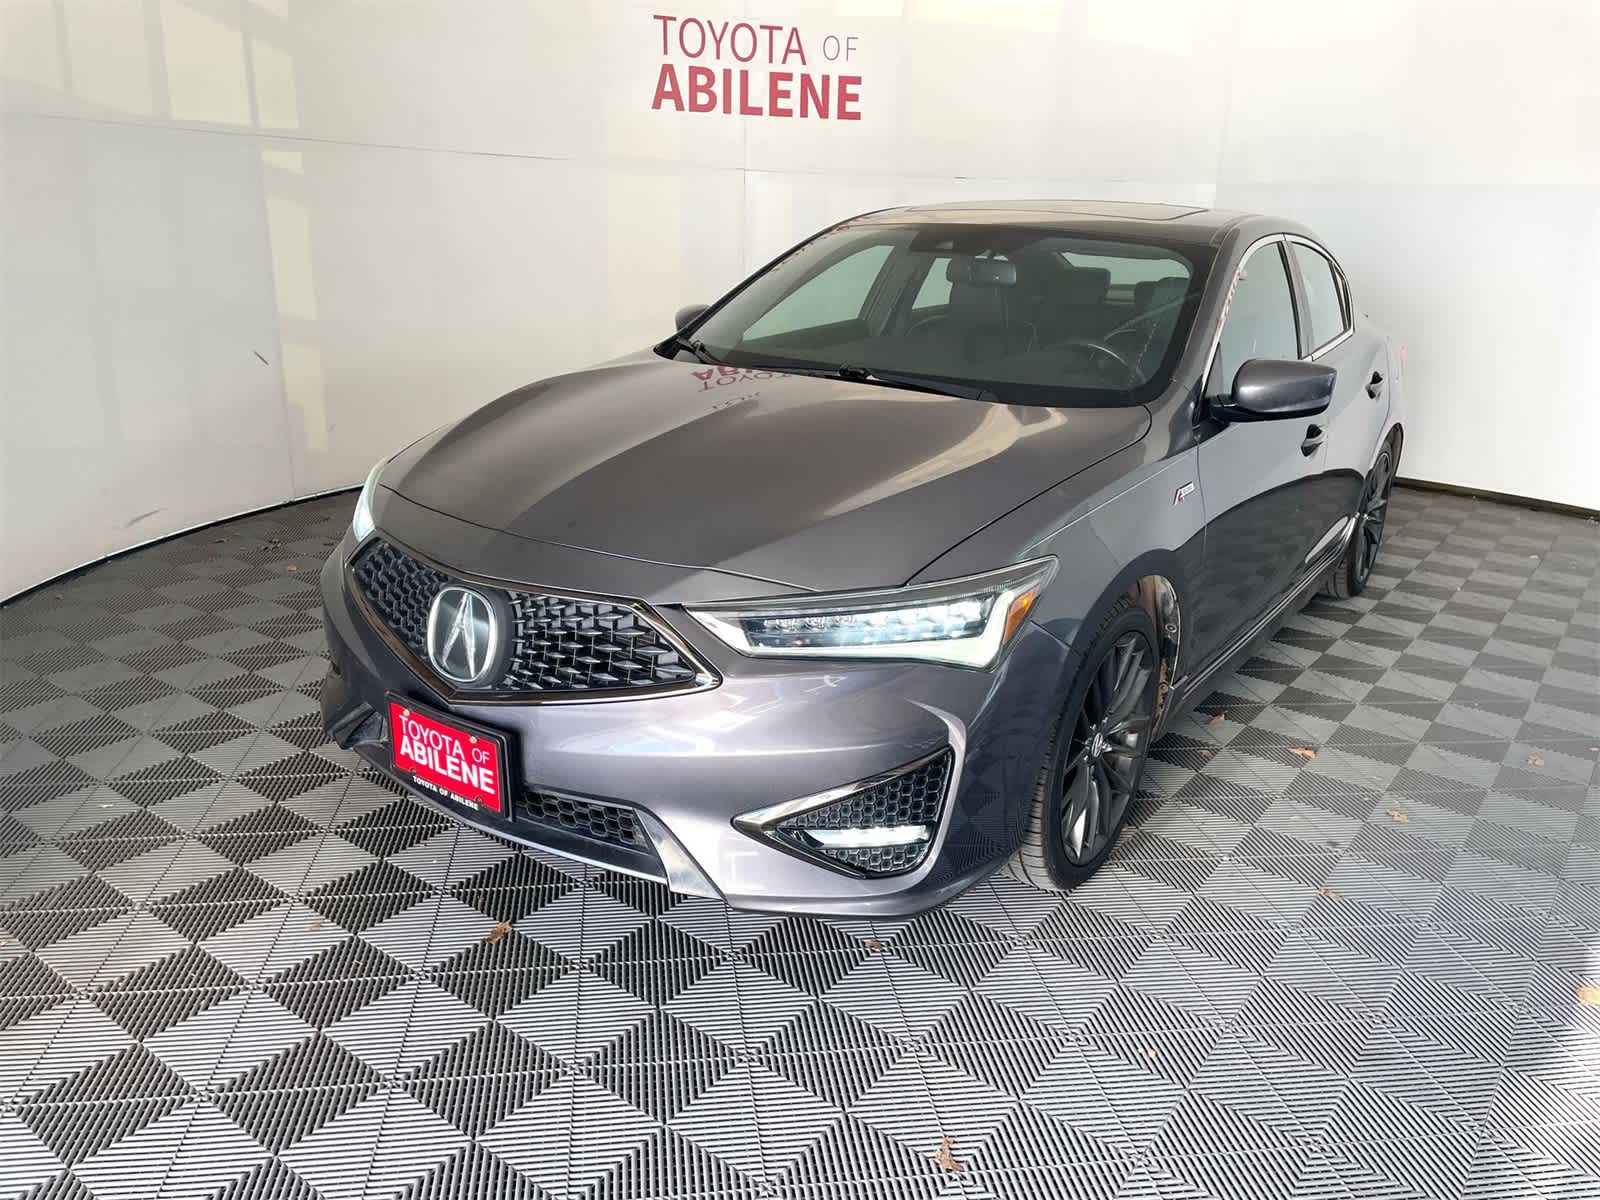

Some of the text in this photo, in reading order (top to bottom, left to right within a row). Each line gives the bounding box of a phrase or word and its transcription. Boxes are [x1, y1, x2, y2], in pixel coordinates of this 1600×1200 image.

[653, 15, 859, 65] TOYOTA OF
[651, 64, 862, 120] ABILENE
[399, 714, 490, 764] TOYOTA OF
[400, 735, 495, 795] ABILENE
[413, 775, 479, 810] TOYOTA OF ABILENE
